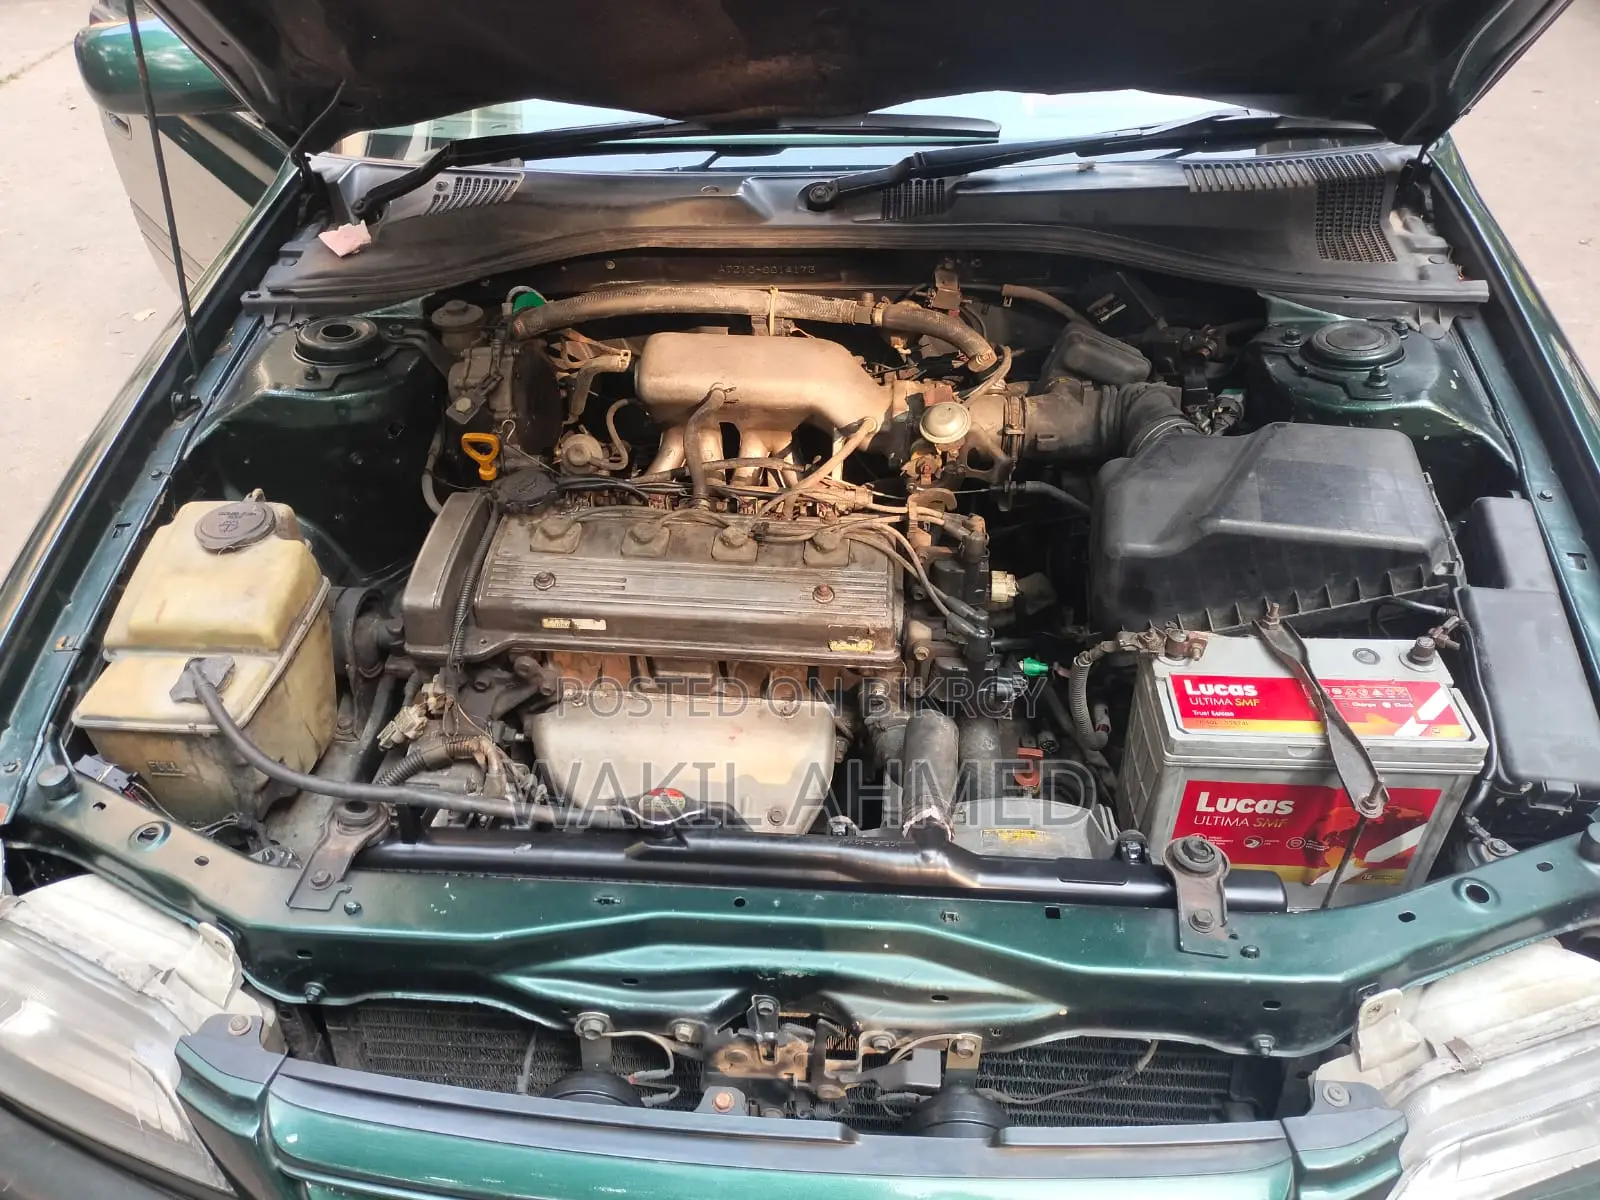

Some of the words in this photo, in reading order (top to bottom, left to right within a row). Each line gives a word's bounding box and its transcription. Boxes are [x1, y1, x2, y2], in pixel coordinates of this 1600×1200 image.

[1183, 679, 1258, 697] Lucas
[1189, 696, 1233, 706] ULTIMA
[1235, 699, 1261, 707] SMF
[1196, 791, 1295, 815] Lucas
[1194, 815, 1250, 827] ULTIMA
[1253, 817, 1288, 828] SMF
